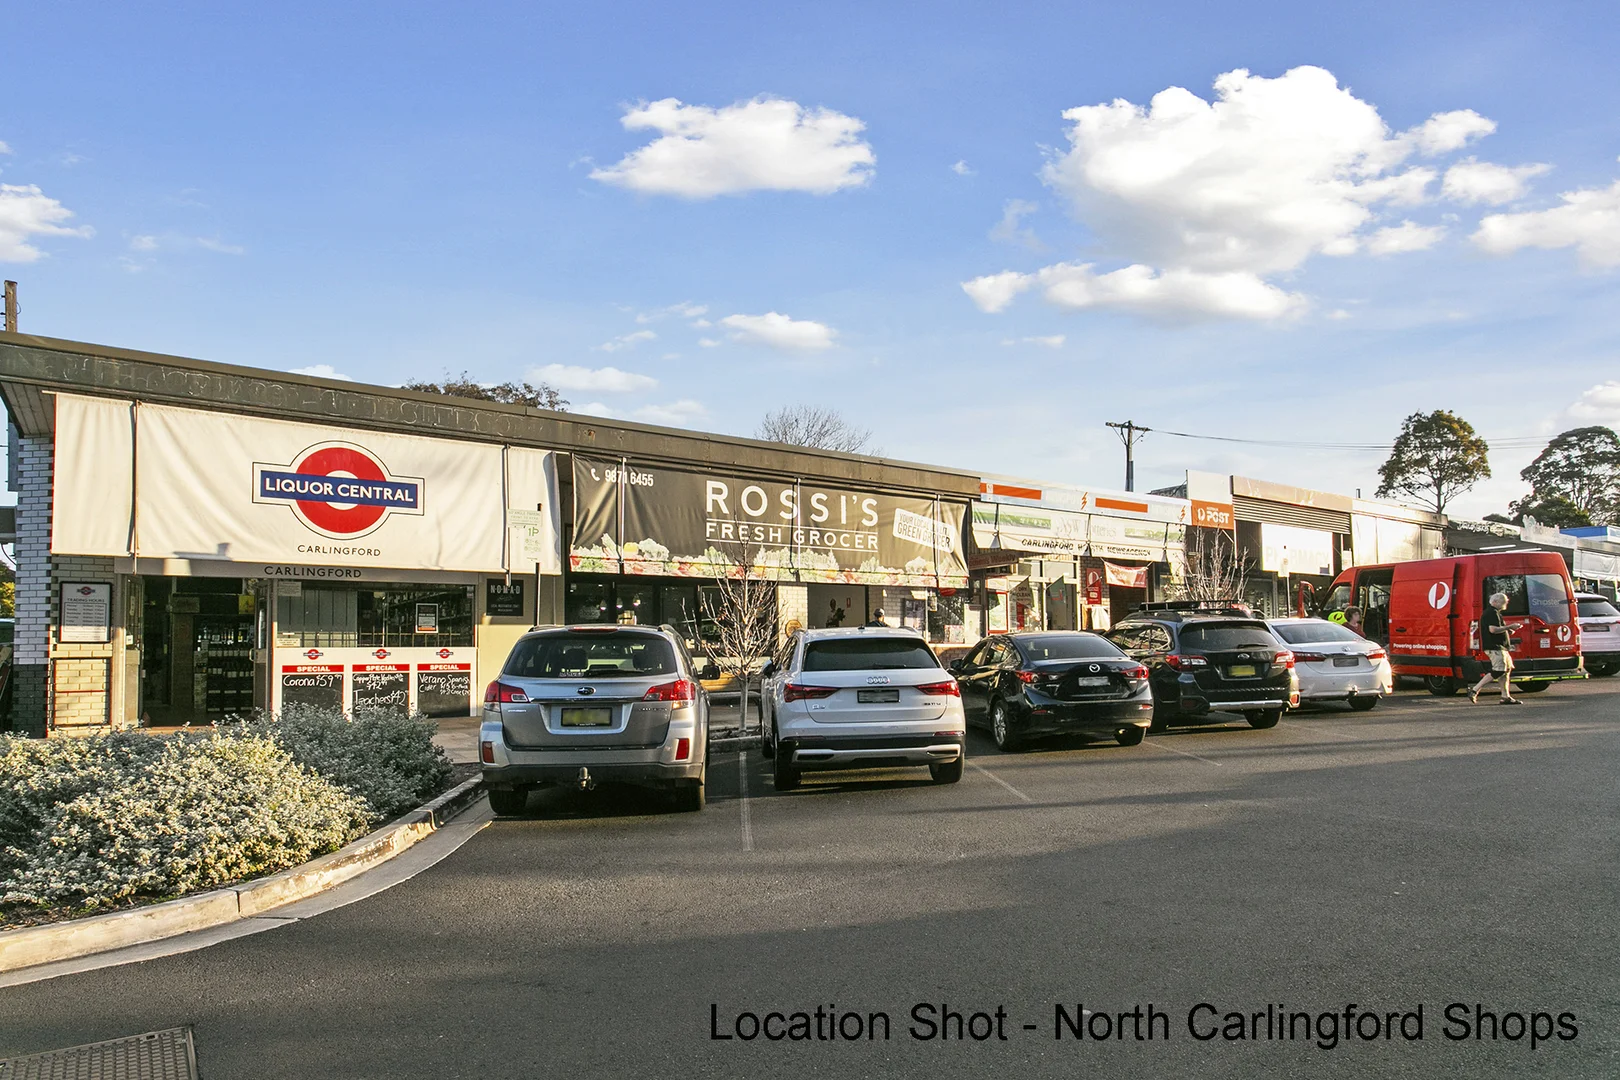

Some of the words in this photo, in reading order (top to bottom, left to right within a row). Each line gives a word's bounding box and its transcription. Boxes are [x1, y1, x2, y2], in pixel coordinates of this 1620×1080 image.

[605, 469, 628, 484] 9871
[630, 472, 654, 487] 6455
[265, 477, 334, 496] LIQUOR
[336, 484, 414, 502] CENTRAL
[706, 480, 879, 527] ROSSI'S
[1206, 510, 1229, 524] POST
[706, 522, 782, 543] FRESH
[792, 529, 879, 549] GROCER
[897, 522, 922, 540] GREEN
[297, 544, 381, 557] CARLINGFORD
[264, 566, 362, 578] CARLINGFORD
[283, 675, 315, 687] Corona
[418, 673, 447, 684] Verano
